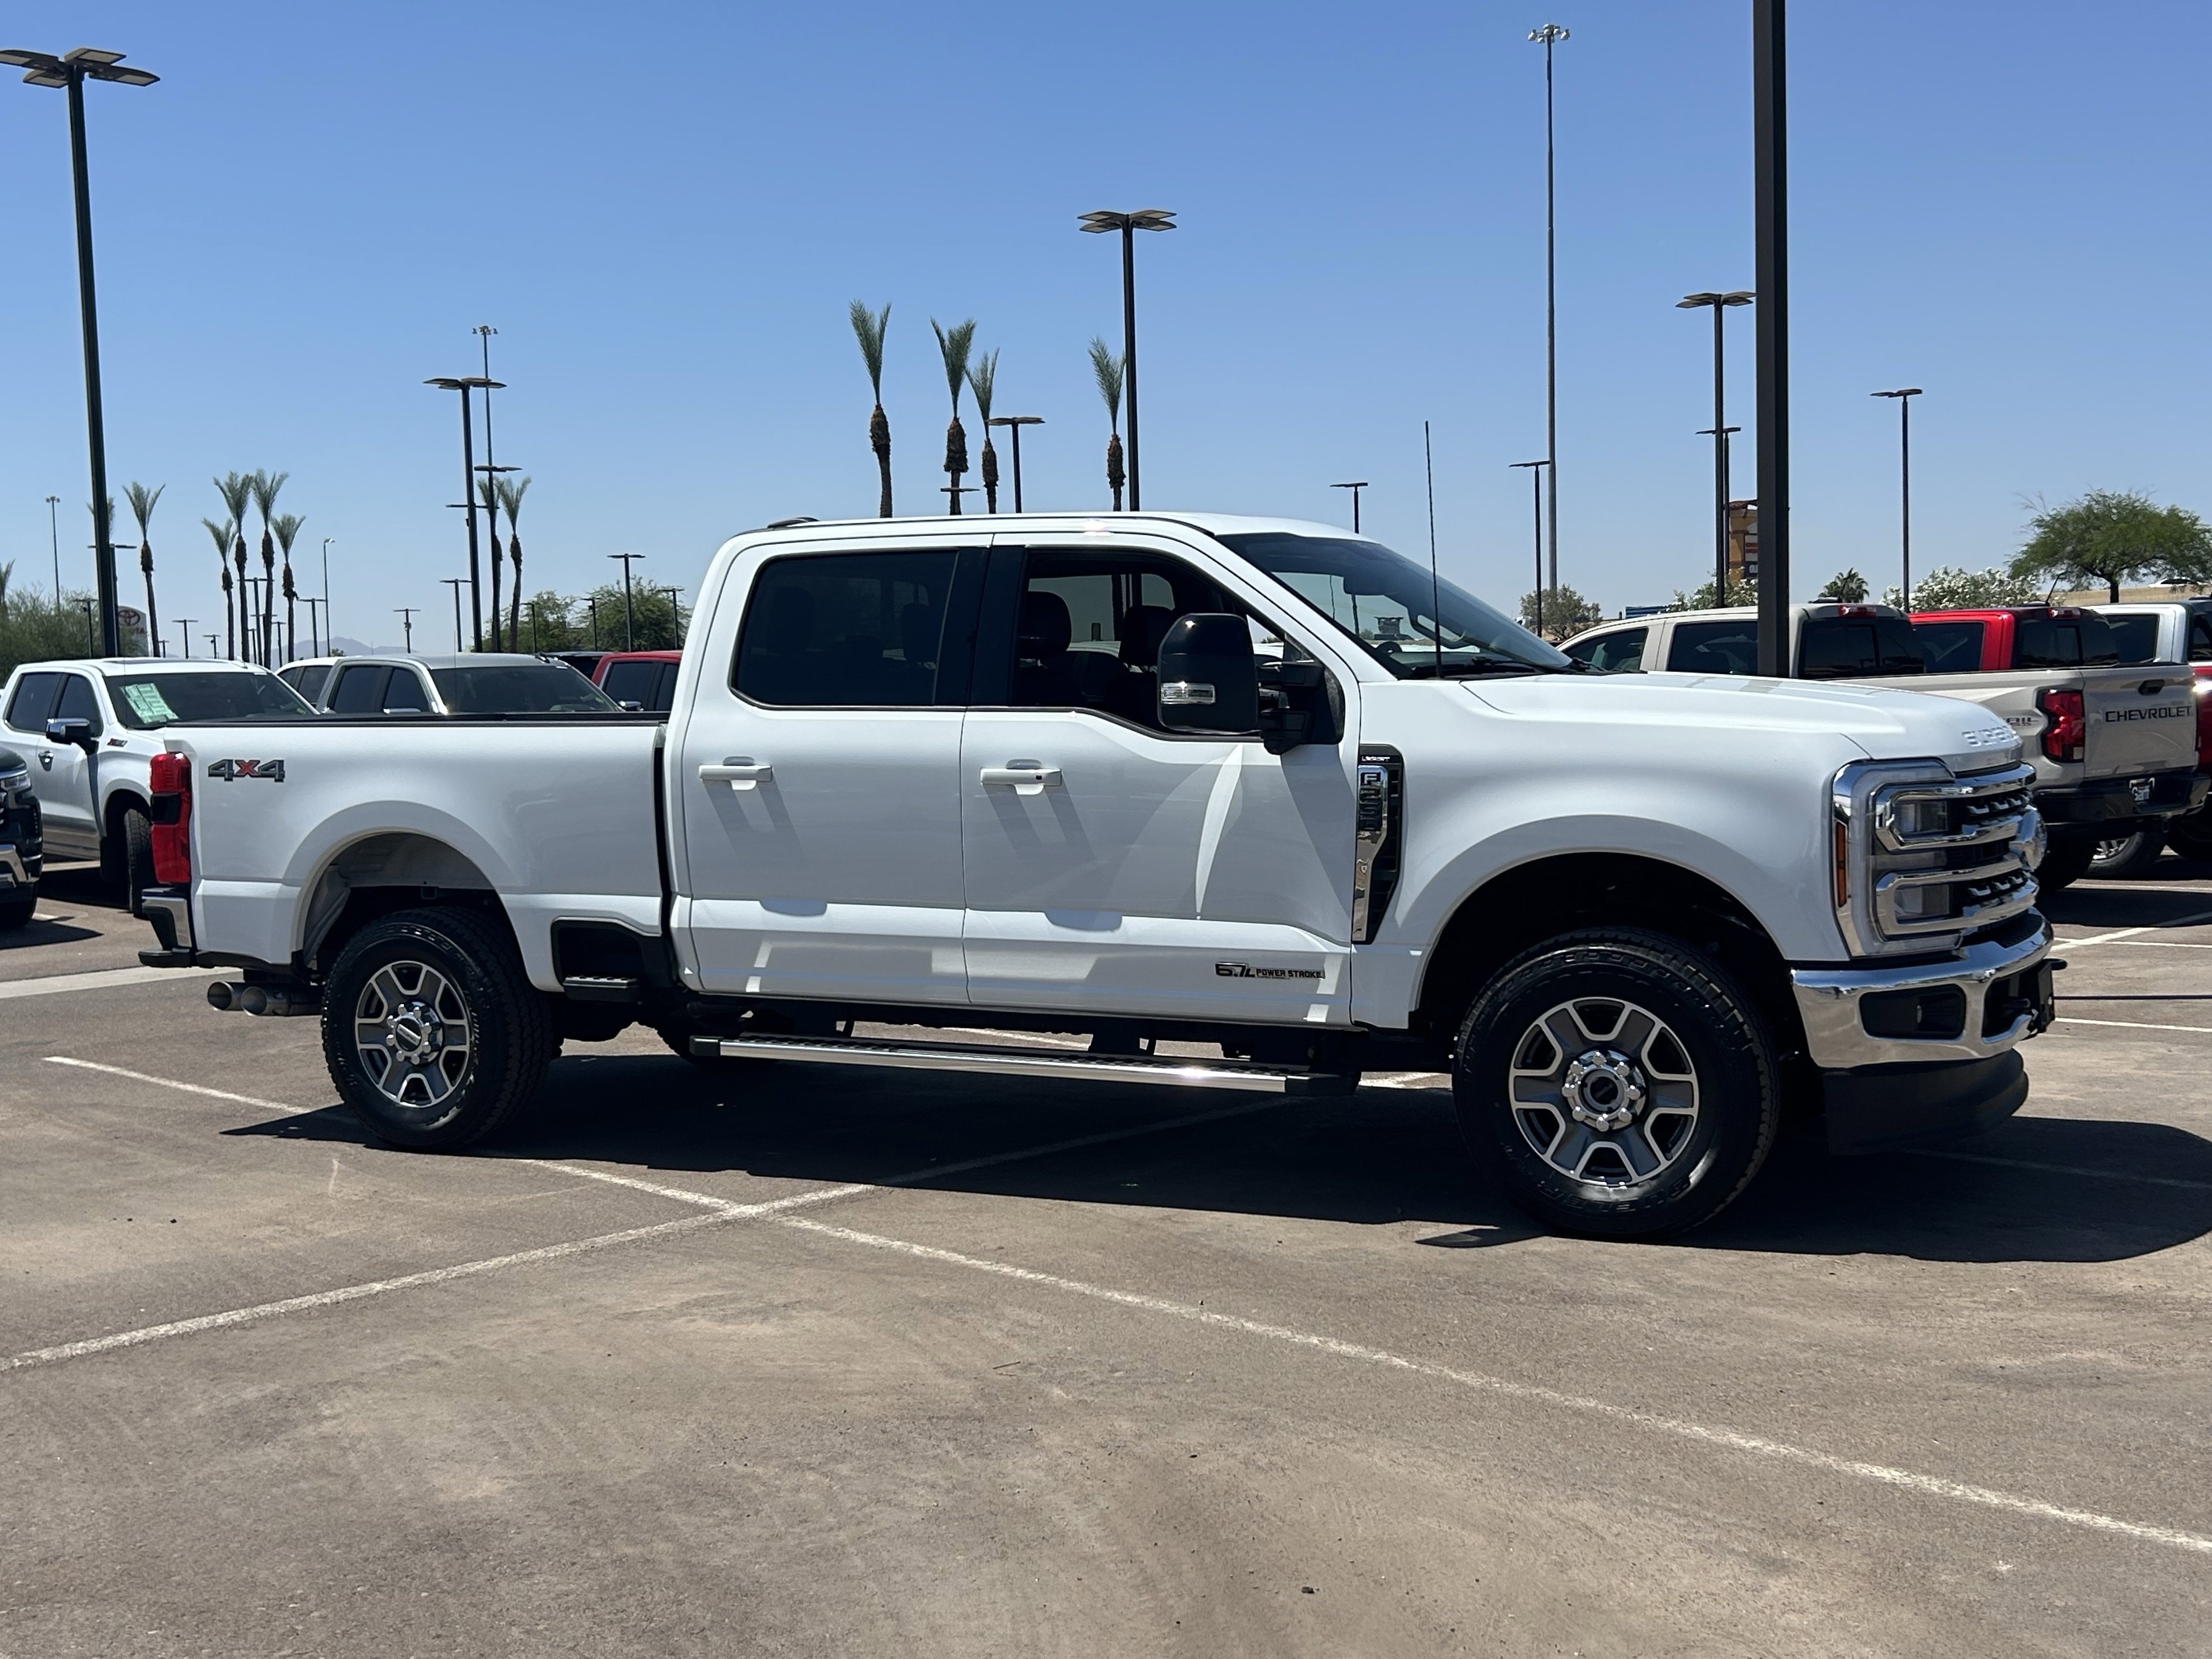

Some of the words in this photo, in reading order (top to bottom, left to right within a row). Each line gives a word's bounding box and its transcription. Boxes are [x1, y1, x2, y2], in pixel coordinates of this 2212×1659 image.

[2105, 706, 2192, 723] CHEVROLET
[1215, 962, 1255, 978] 6.7L
[1256, 968, 1286, 977] POWER
[1288, 969, 1323, 979] STROKE
